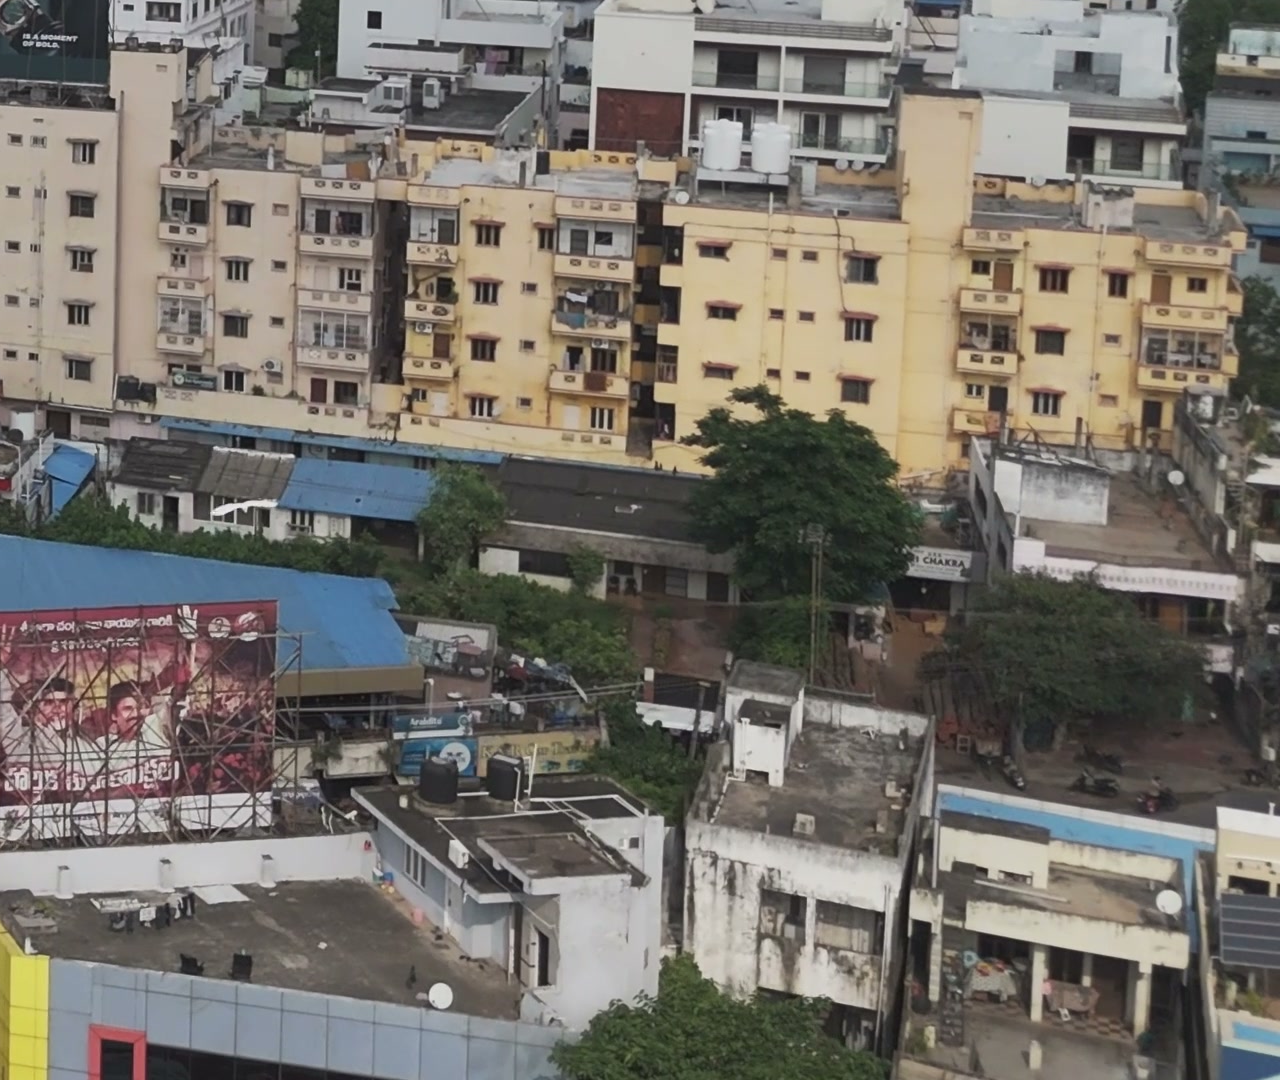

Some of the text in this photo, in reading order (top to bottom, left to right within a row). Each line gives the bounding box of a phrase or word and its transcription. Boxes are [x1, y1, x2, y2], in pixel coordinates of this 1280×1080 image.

[40, 34, 78, 42] MOMENT
[22, 40, 34, 48] OF
[922, 556, 966, 569] CHAKRA
